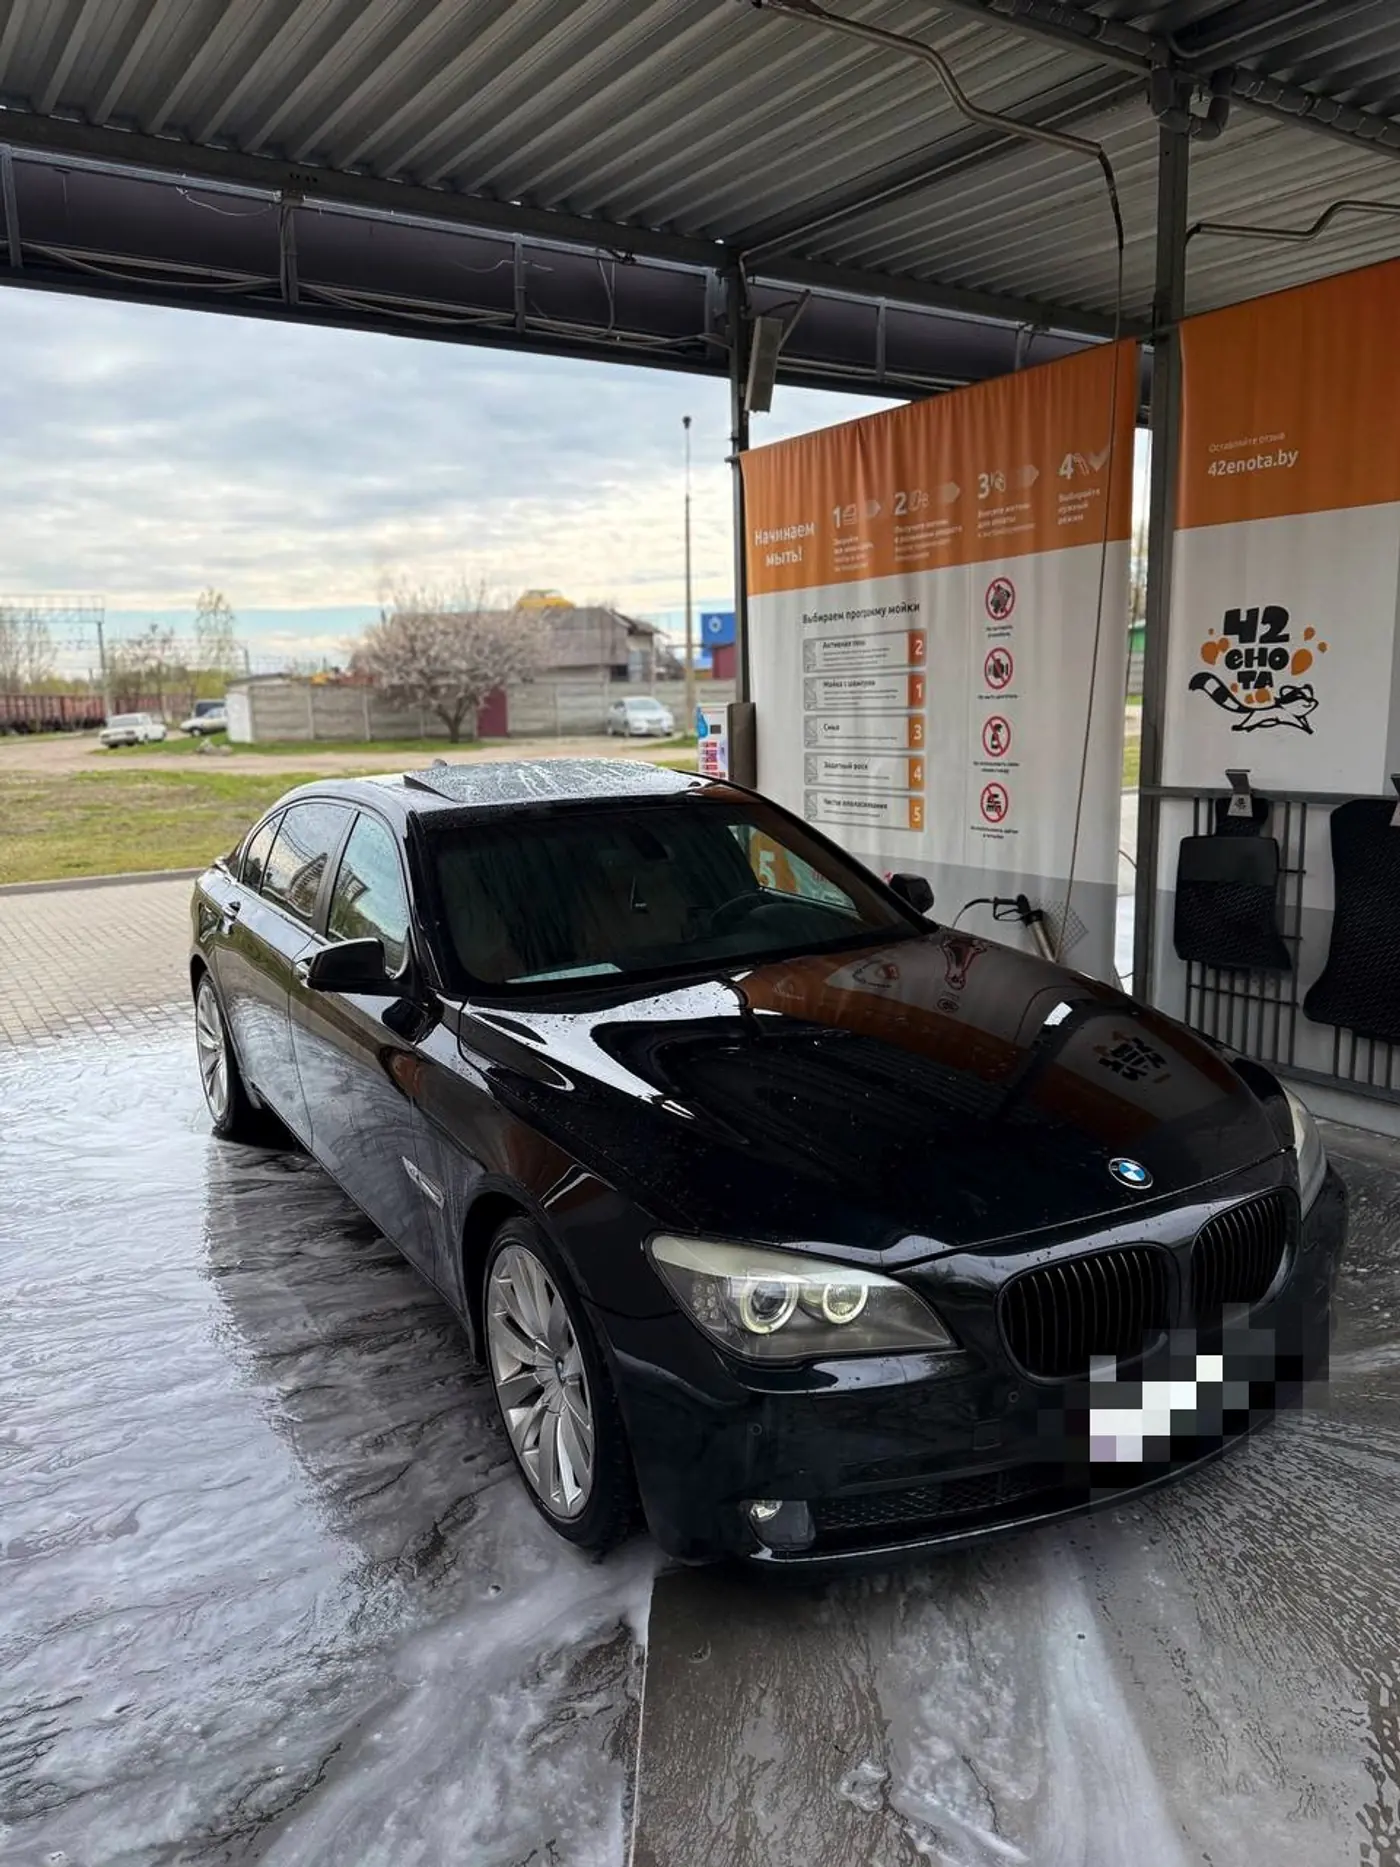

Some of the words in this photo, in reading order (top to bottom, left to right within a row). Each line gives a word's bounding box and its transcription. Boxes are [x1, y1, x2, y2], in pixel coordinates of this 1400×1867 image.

[1058, 453, 1074, 480] 4
[1207, 449, 1299, 476] 42enota.by
[977, 473, 990, 499] 3
[894, 492, 907, 516] 2
[832, 505, 841, 528] 1
[755, 522, 815, 546] Начинаем
[888, 601, 920, 614] мойки
[1223, 605, 1290, 644] 42
[914, 639, 923, 656] 2
[915, 682, 922, 699] 1
[914, 724, 922, 740] 3
[914, 766, 922, 781] 4
[913, 806, 921, 822] 5
